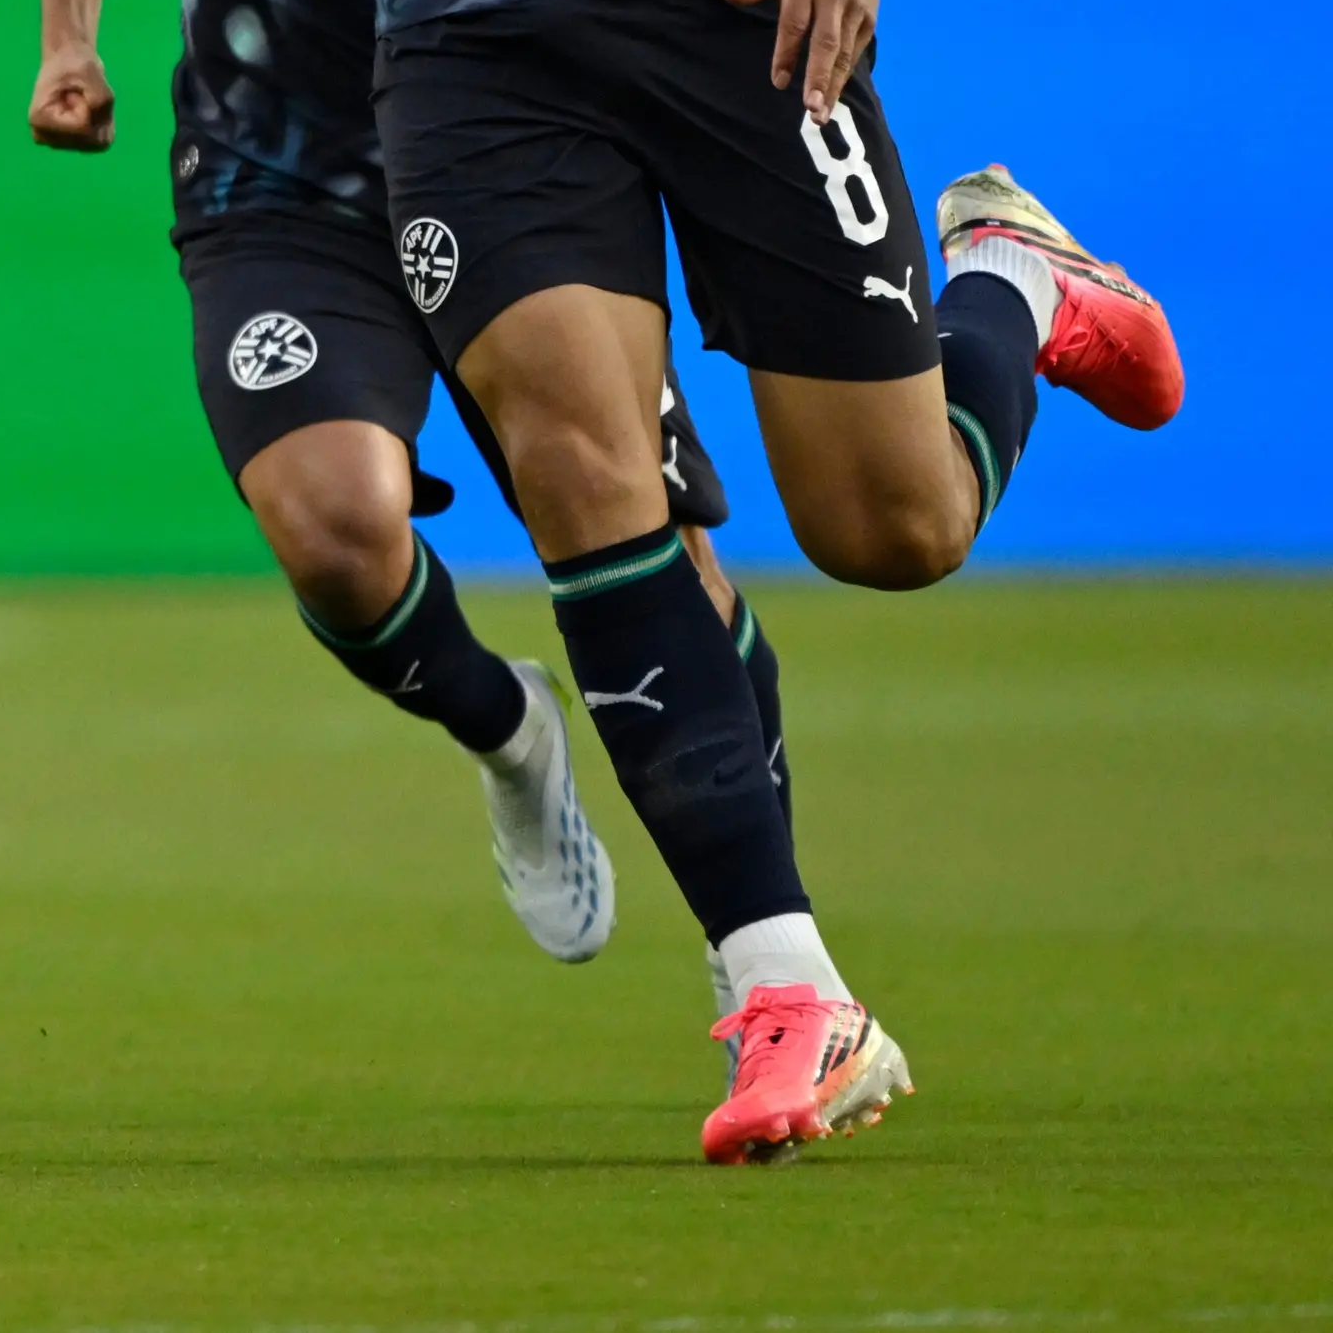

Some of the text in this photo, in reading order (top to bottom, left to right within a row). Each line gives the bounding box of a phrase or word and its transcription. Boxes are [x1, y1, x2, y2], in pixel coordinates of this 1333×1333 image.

[800, 100, 890, 246] 8
[405, 224, 423, 253] APF
[250, 317, 279, 338] APF
